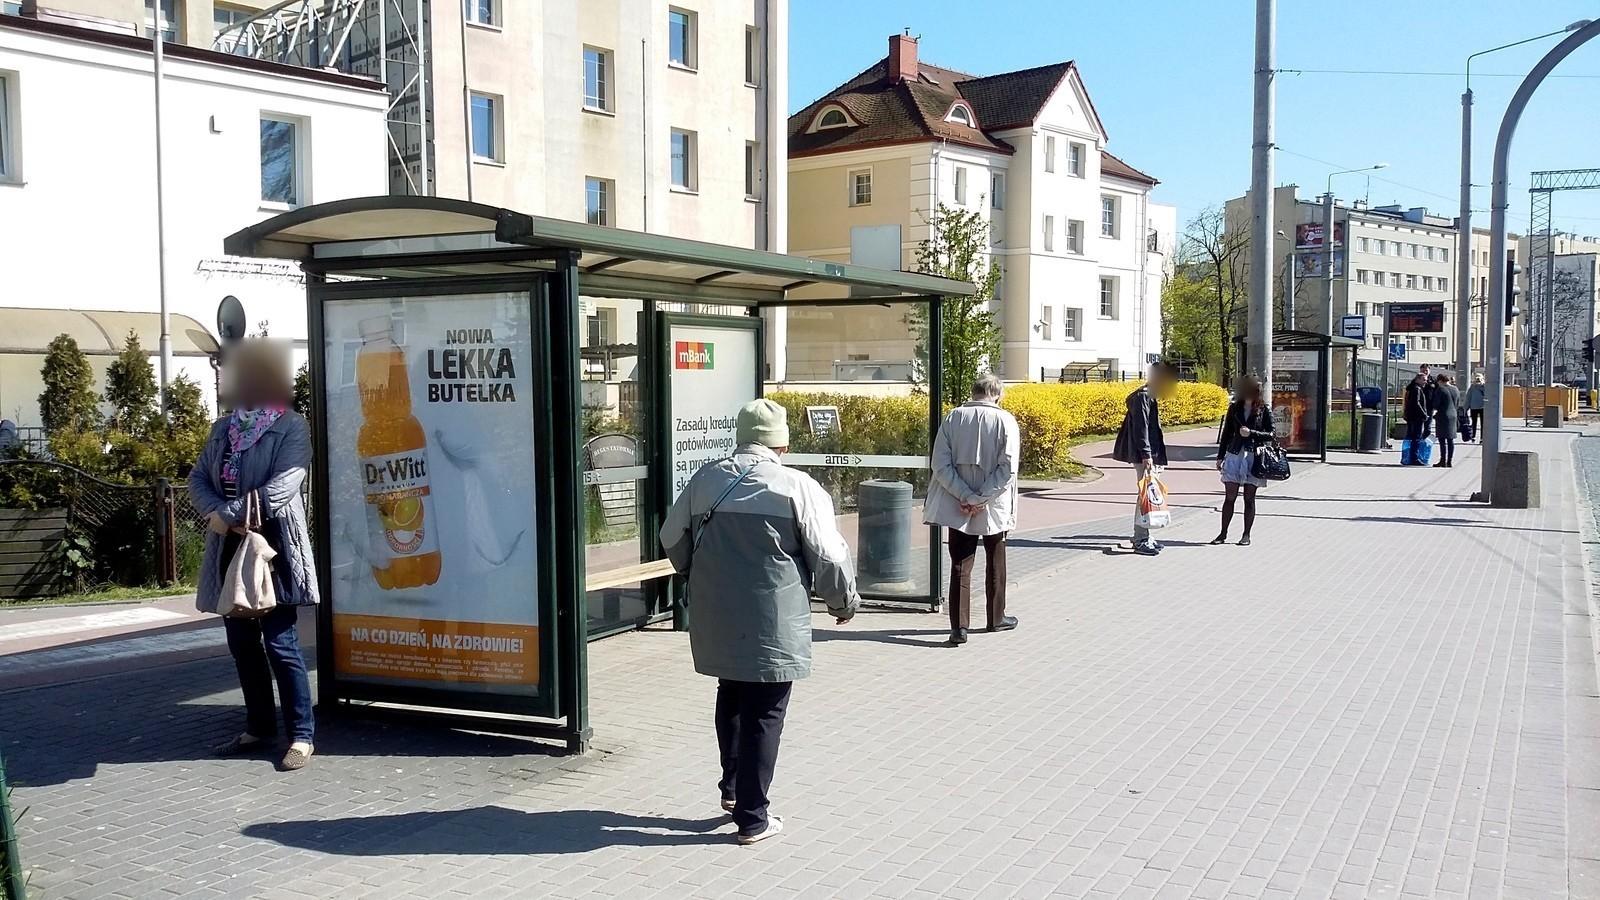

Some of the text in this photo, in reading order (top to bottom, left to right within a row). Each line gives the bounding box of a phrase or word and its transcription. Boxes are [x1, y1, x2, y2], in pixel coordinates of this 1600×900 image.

[446, 328, 494, 345] NOWA
[427, 347, 516, 380] LEKKA
[679, 349, 711, 363] mBank
[428, 383, 516, 403] BUTELKA
[676, 416, 708, 434] Zasady
[676, 436, 733, 455] gotówkowego
[676, 460, 688, 474] są
[825, 455, 849, 465] ams
[351, 627, 524, 653] NA CO DZIEŃ, NA ZDROWIE!
